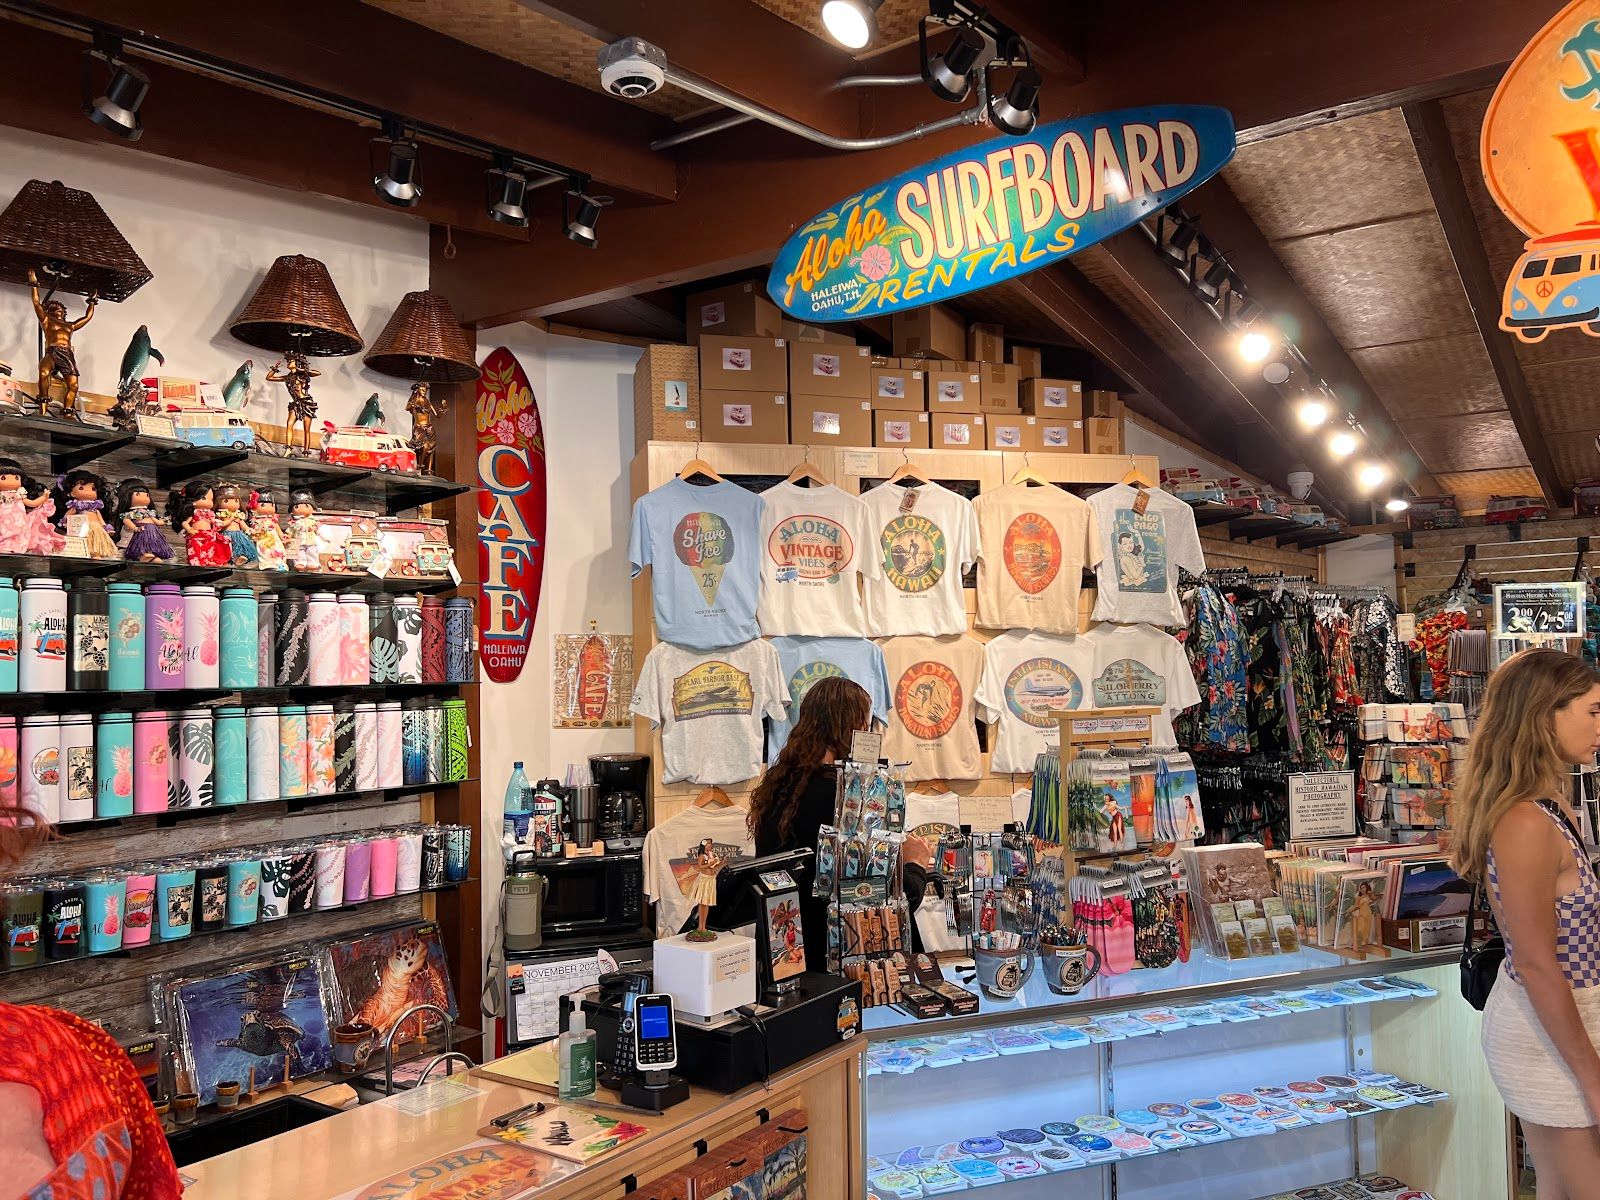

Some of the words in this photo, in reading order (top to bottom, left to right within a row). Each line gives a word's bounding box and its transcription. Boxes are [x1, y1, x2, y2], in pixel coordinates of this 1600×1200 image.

[894, 120, 1200, 270] SURFBOARD
[784, 206, 888, 306] Aloha
[878, 223, 1081, 308] RENTALS
[779, 519, 840, 544] ALOHA
[884, 516, 941, 544] ALOHA
[1008, 513, 1054, 537] ALOHA
[1133, 521, 1159, 531] PAGO
[477, 445, 537, 641] CAFE
[682, 526, 727, 548] Shave
[694, 543, 721, 563] Ice
[779, 543, 844, 561] VINTAGE
[798, 557, 826, 568] VIBES
[886, 566, 943, 592] HAWAII
[44, 617, 66, 631] ALOHA
[483, 643, 527, 656] HALEIWA
[489, 656, 522, 669] OAHU
[683, 677, 702, 687] PEARL
[703, 674, 725, 684] HARBOR
[726, 674, 741, 682] BASE
[792, 661, 844, 693] ALOH
[900, 662, 958, 692] ALOHA
[1295, 785, 1318, 794] HISTORIC
[1321, 783, 1348, 792] HAWAIIAN
[1303, 792, 1342, 800] PHOTOGRAPHY
[512, 886, 530, 894] YETI
[12, 911, 37, 925] ALOHA
[60, 903, 82, 920] ALOHA
[524, 965, 578, 979] NOVEMBER
